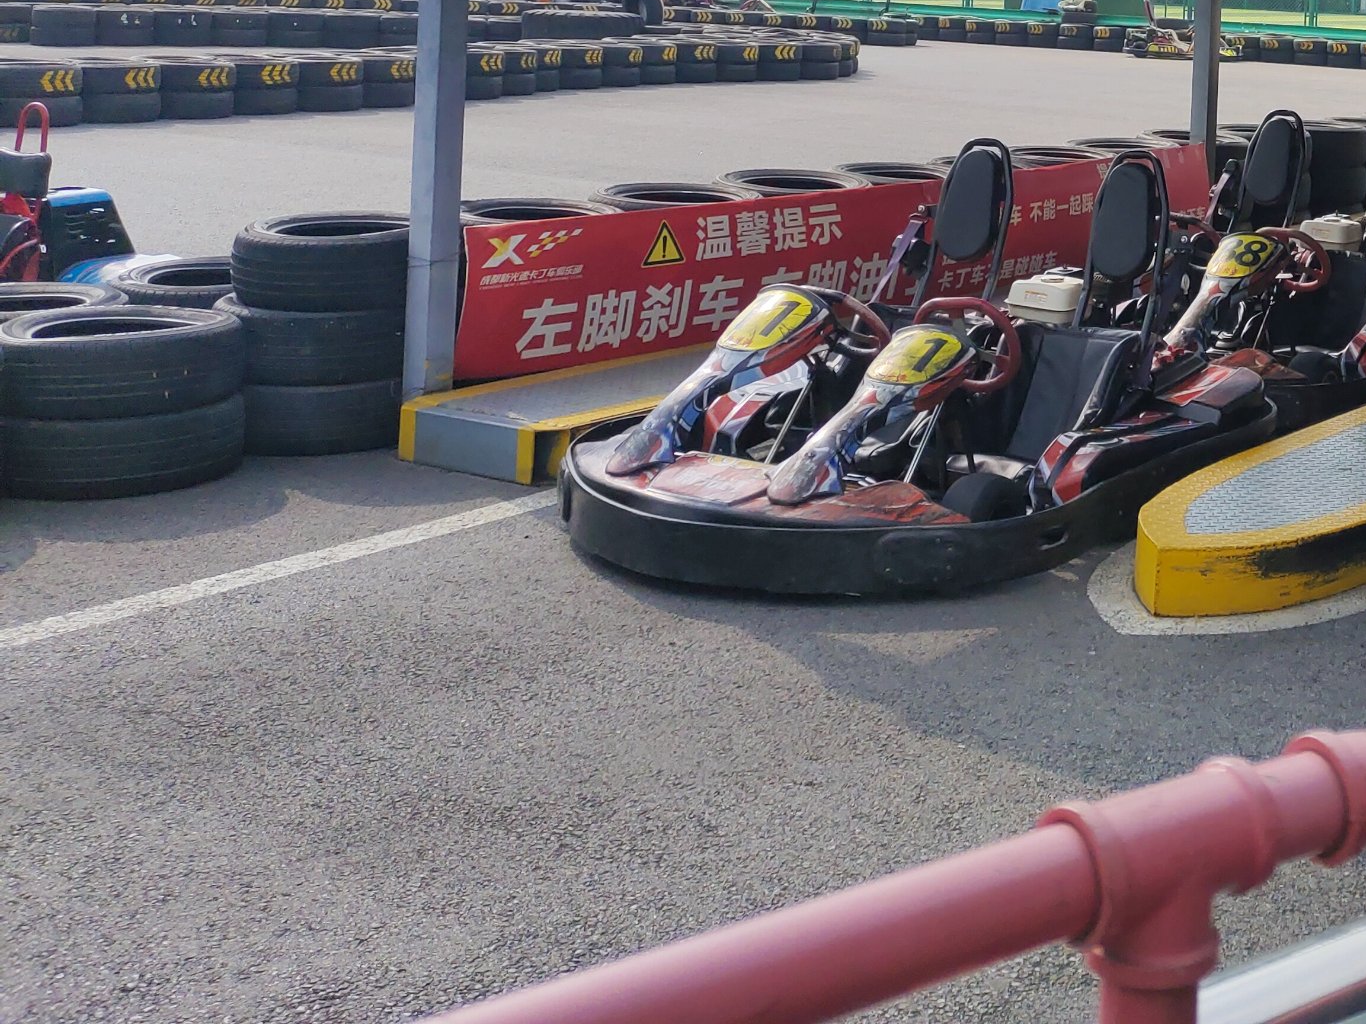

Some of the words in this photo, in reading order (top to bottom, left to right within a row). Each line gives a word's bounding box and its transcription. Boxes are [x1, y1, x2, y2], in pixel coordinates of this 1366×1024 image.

[695, 203, 843, 262] 温馨提示
[515, 275, 744, 360] 左脚刹车
